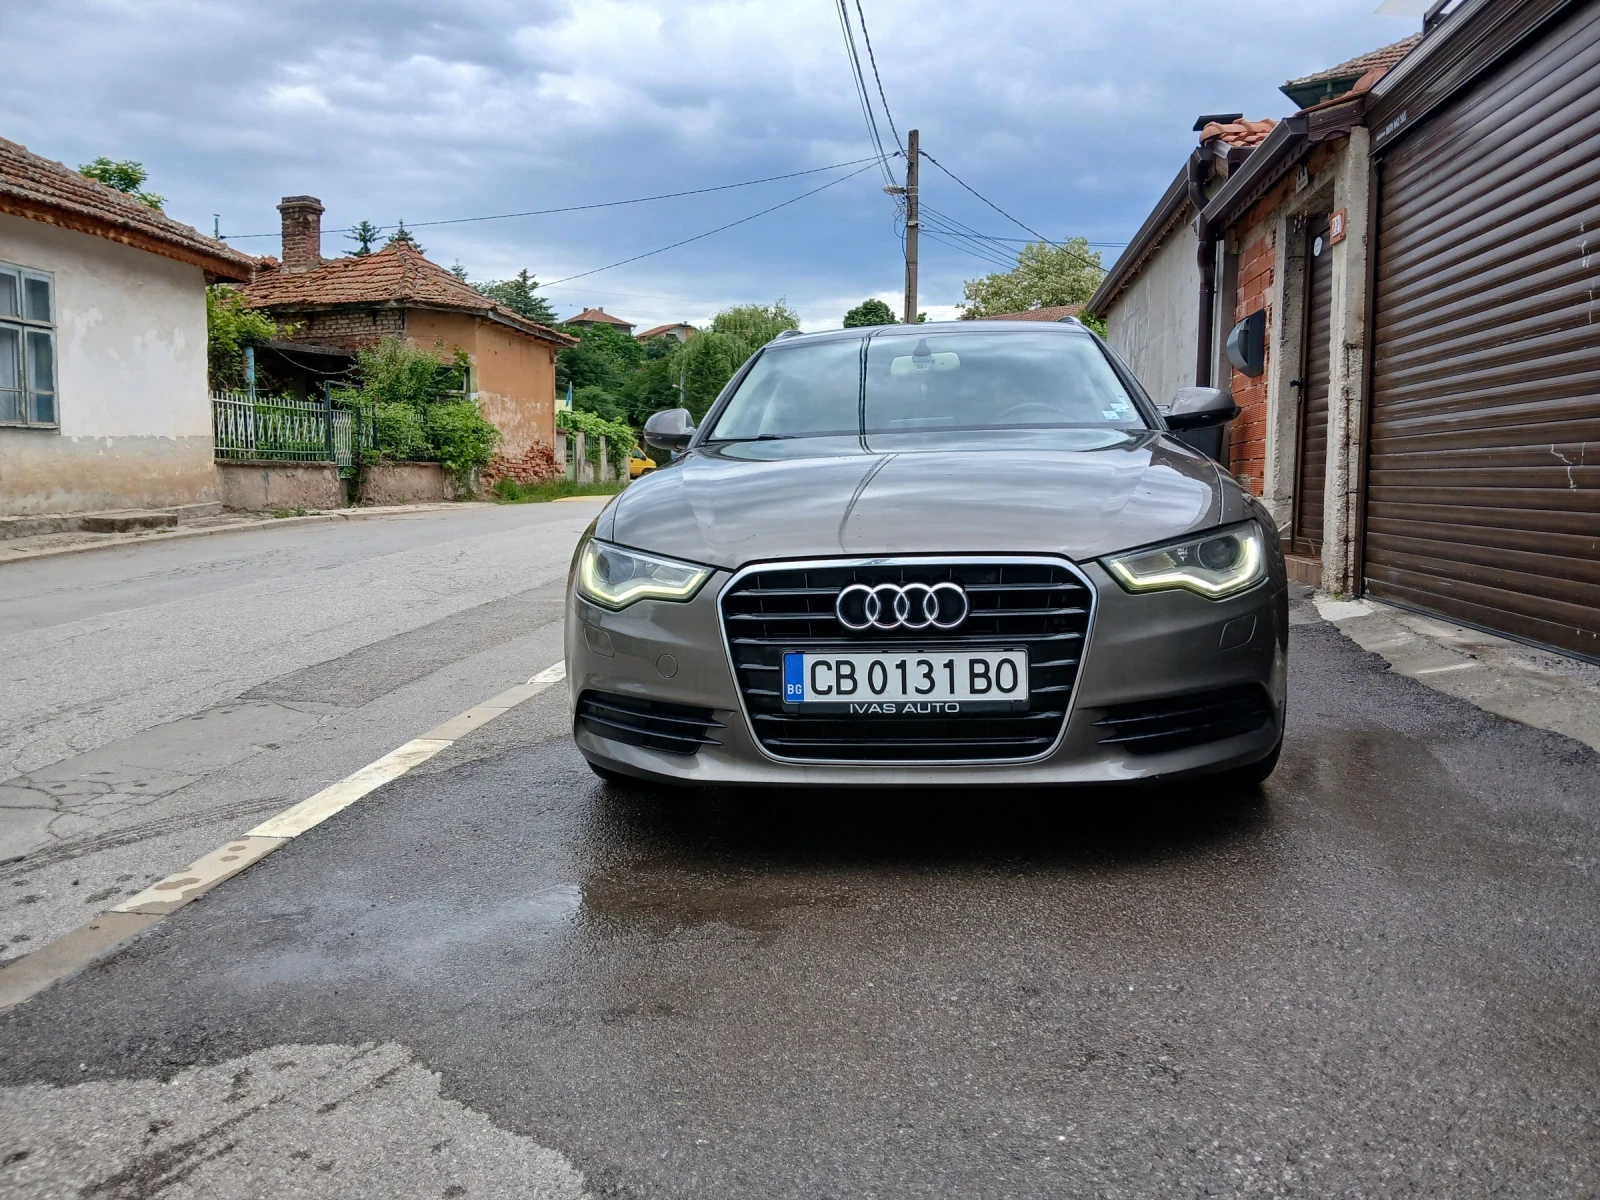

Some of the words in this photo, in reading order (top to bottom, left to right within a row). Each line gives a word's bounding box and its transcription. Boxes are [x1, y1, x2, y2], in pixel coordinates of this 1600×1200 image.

[810, 660, 858, 695] CB
[867, 659, 955, 695] 0131
[968, 657, 1018, 694] BO
[787, 684, 803, 695] BG
[849, 703, 896, 714] IVAS
[902, 702, 960, 713] AUTO
